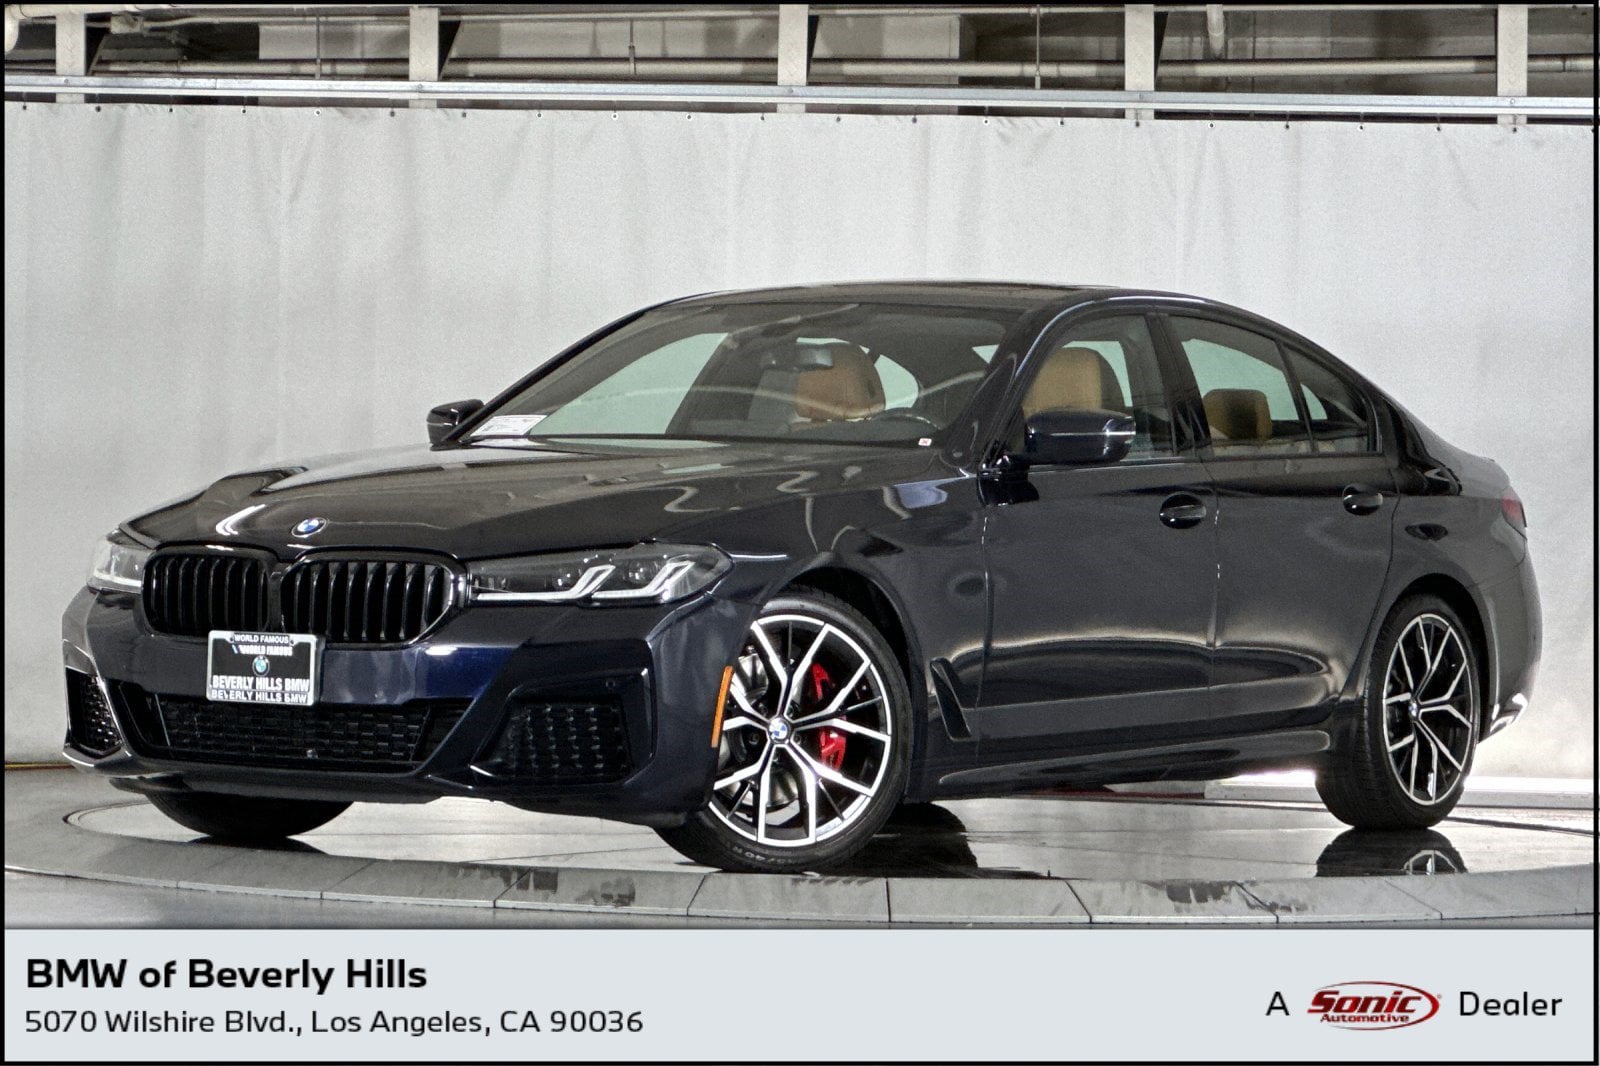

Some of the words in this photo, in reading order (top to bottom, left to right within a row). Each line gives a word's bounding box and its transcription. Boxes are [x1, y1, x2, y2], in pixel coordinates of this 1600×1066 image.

[235, 633, 259, 643] WORLD
[260, 634, 289, 644] FAMOUS
[238, 645, 265, 655] WORLD
[266, 646, 293, 656] FAMOUS
[212, 675, 254, 689] BEVERLY
[255, 676, 283, 691] HILLS
[284, 678, 310, 692] BMW
[211, 689, 254, 701] BEVERLY
[255, 691, 281, 702] HILLS
[284, 692, 308, 704] BMW
